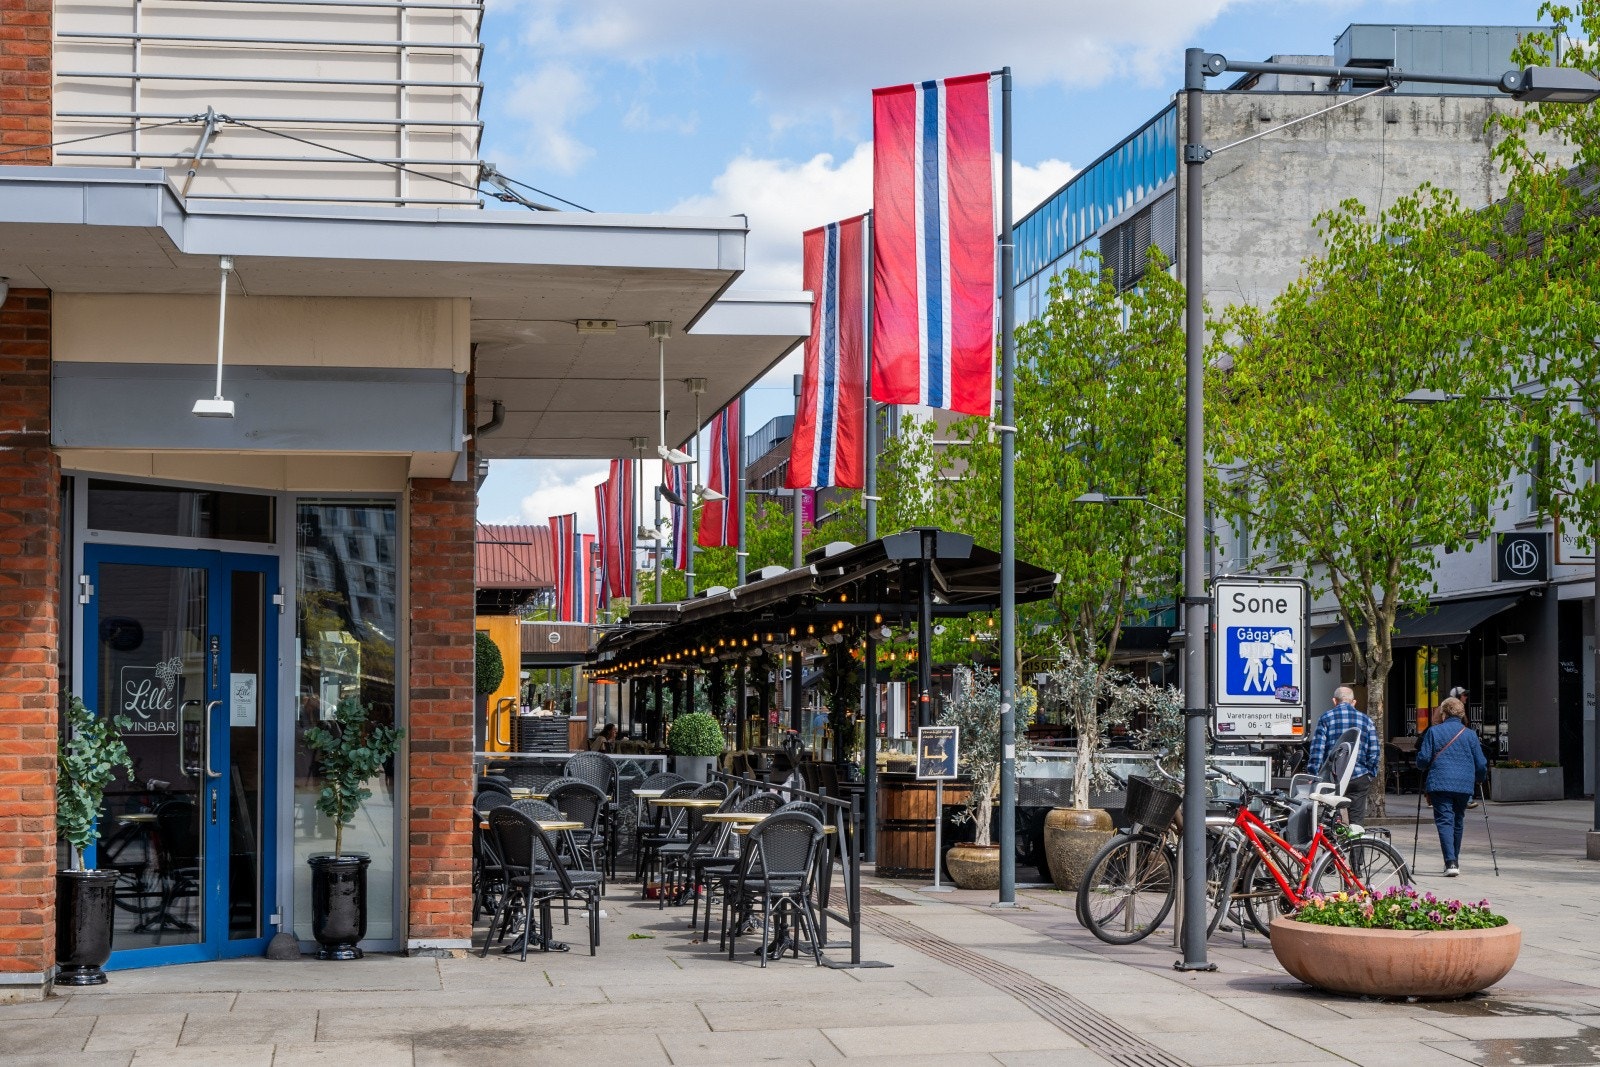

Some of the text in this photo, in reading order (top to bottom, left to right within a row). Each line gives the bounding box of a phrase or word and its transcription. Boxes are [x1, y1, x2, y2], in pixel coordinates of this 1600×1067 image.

[1232, 592, 1288, 614] Sone
[1237, 628, 1279, 643] Gågat
[1227, 712, 1272, 720] Varetransport
[132, 721, 176, 731] INBAR
